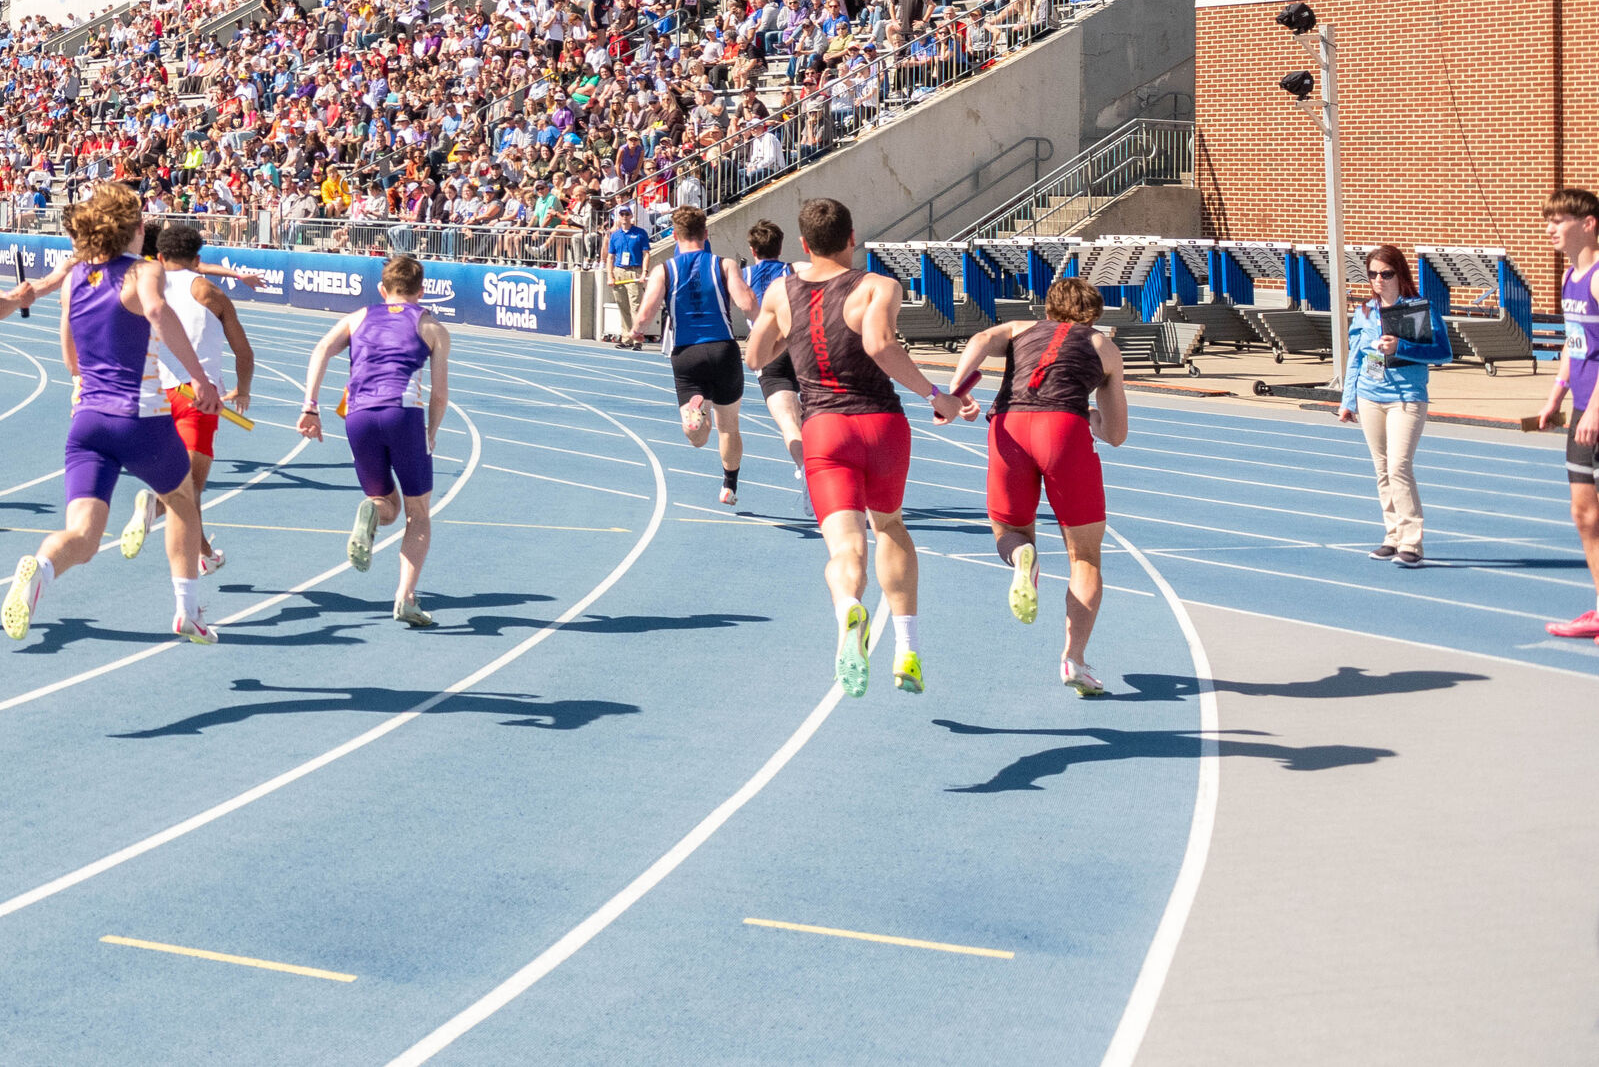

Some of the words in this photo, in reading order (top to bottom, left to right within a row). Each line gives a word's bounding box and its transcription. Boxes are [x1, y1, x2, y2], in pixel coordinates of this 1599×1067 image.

[293, 269, 362, 296] SCHEELS
[422, 278, 453, 295] RELAYS
[483, 272, 547, 310] Smart
[496, 306, 538, 329] Honda
